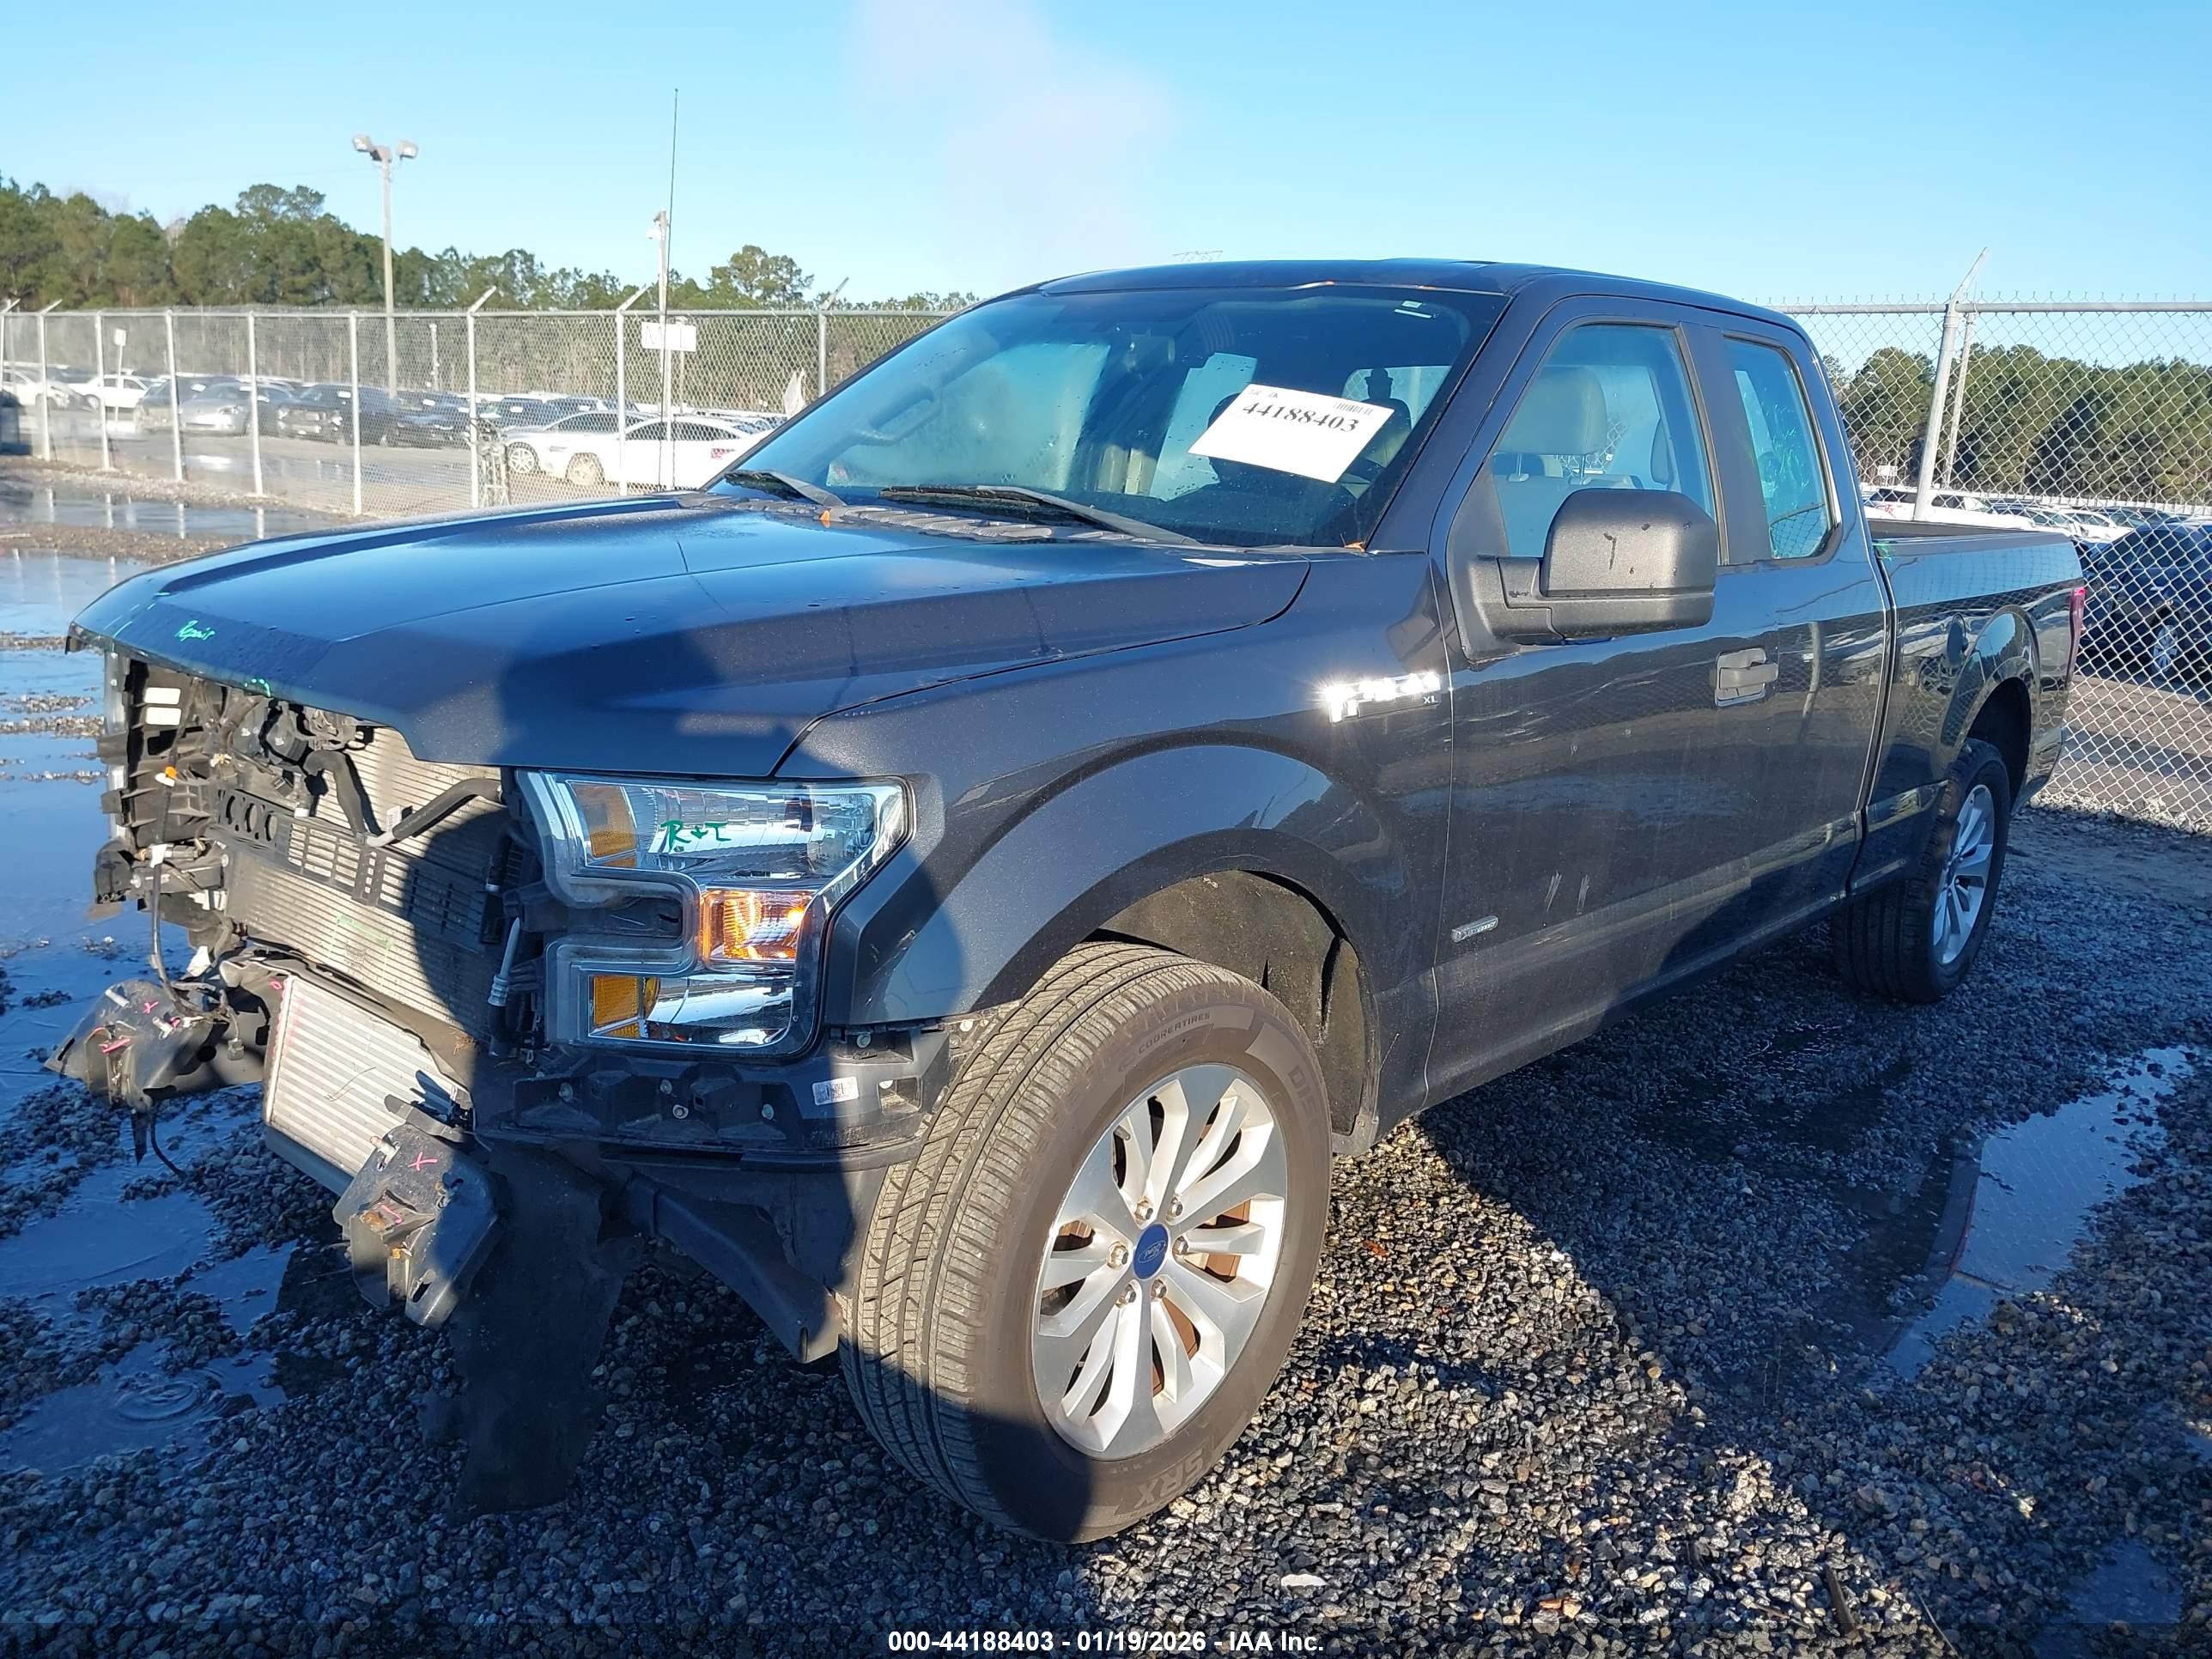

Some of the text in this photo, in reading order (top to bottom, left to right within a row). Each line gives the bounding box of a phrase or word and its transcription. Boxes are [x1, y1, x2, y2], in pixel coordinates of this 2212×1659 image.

[1243, 402, 1359, 432] 44188403
[1423, 695, 1438, 704] XL
[1133, 1447, 1203, 1510] SRX
